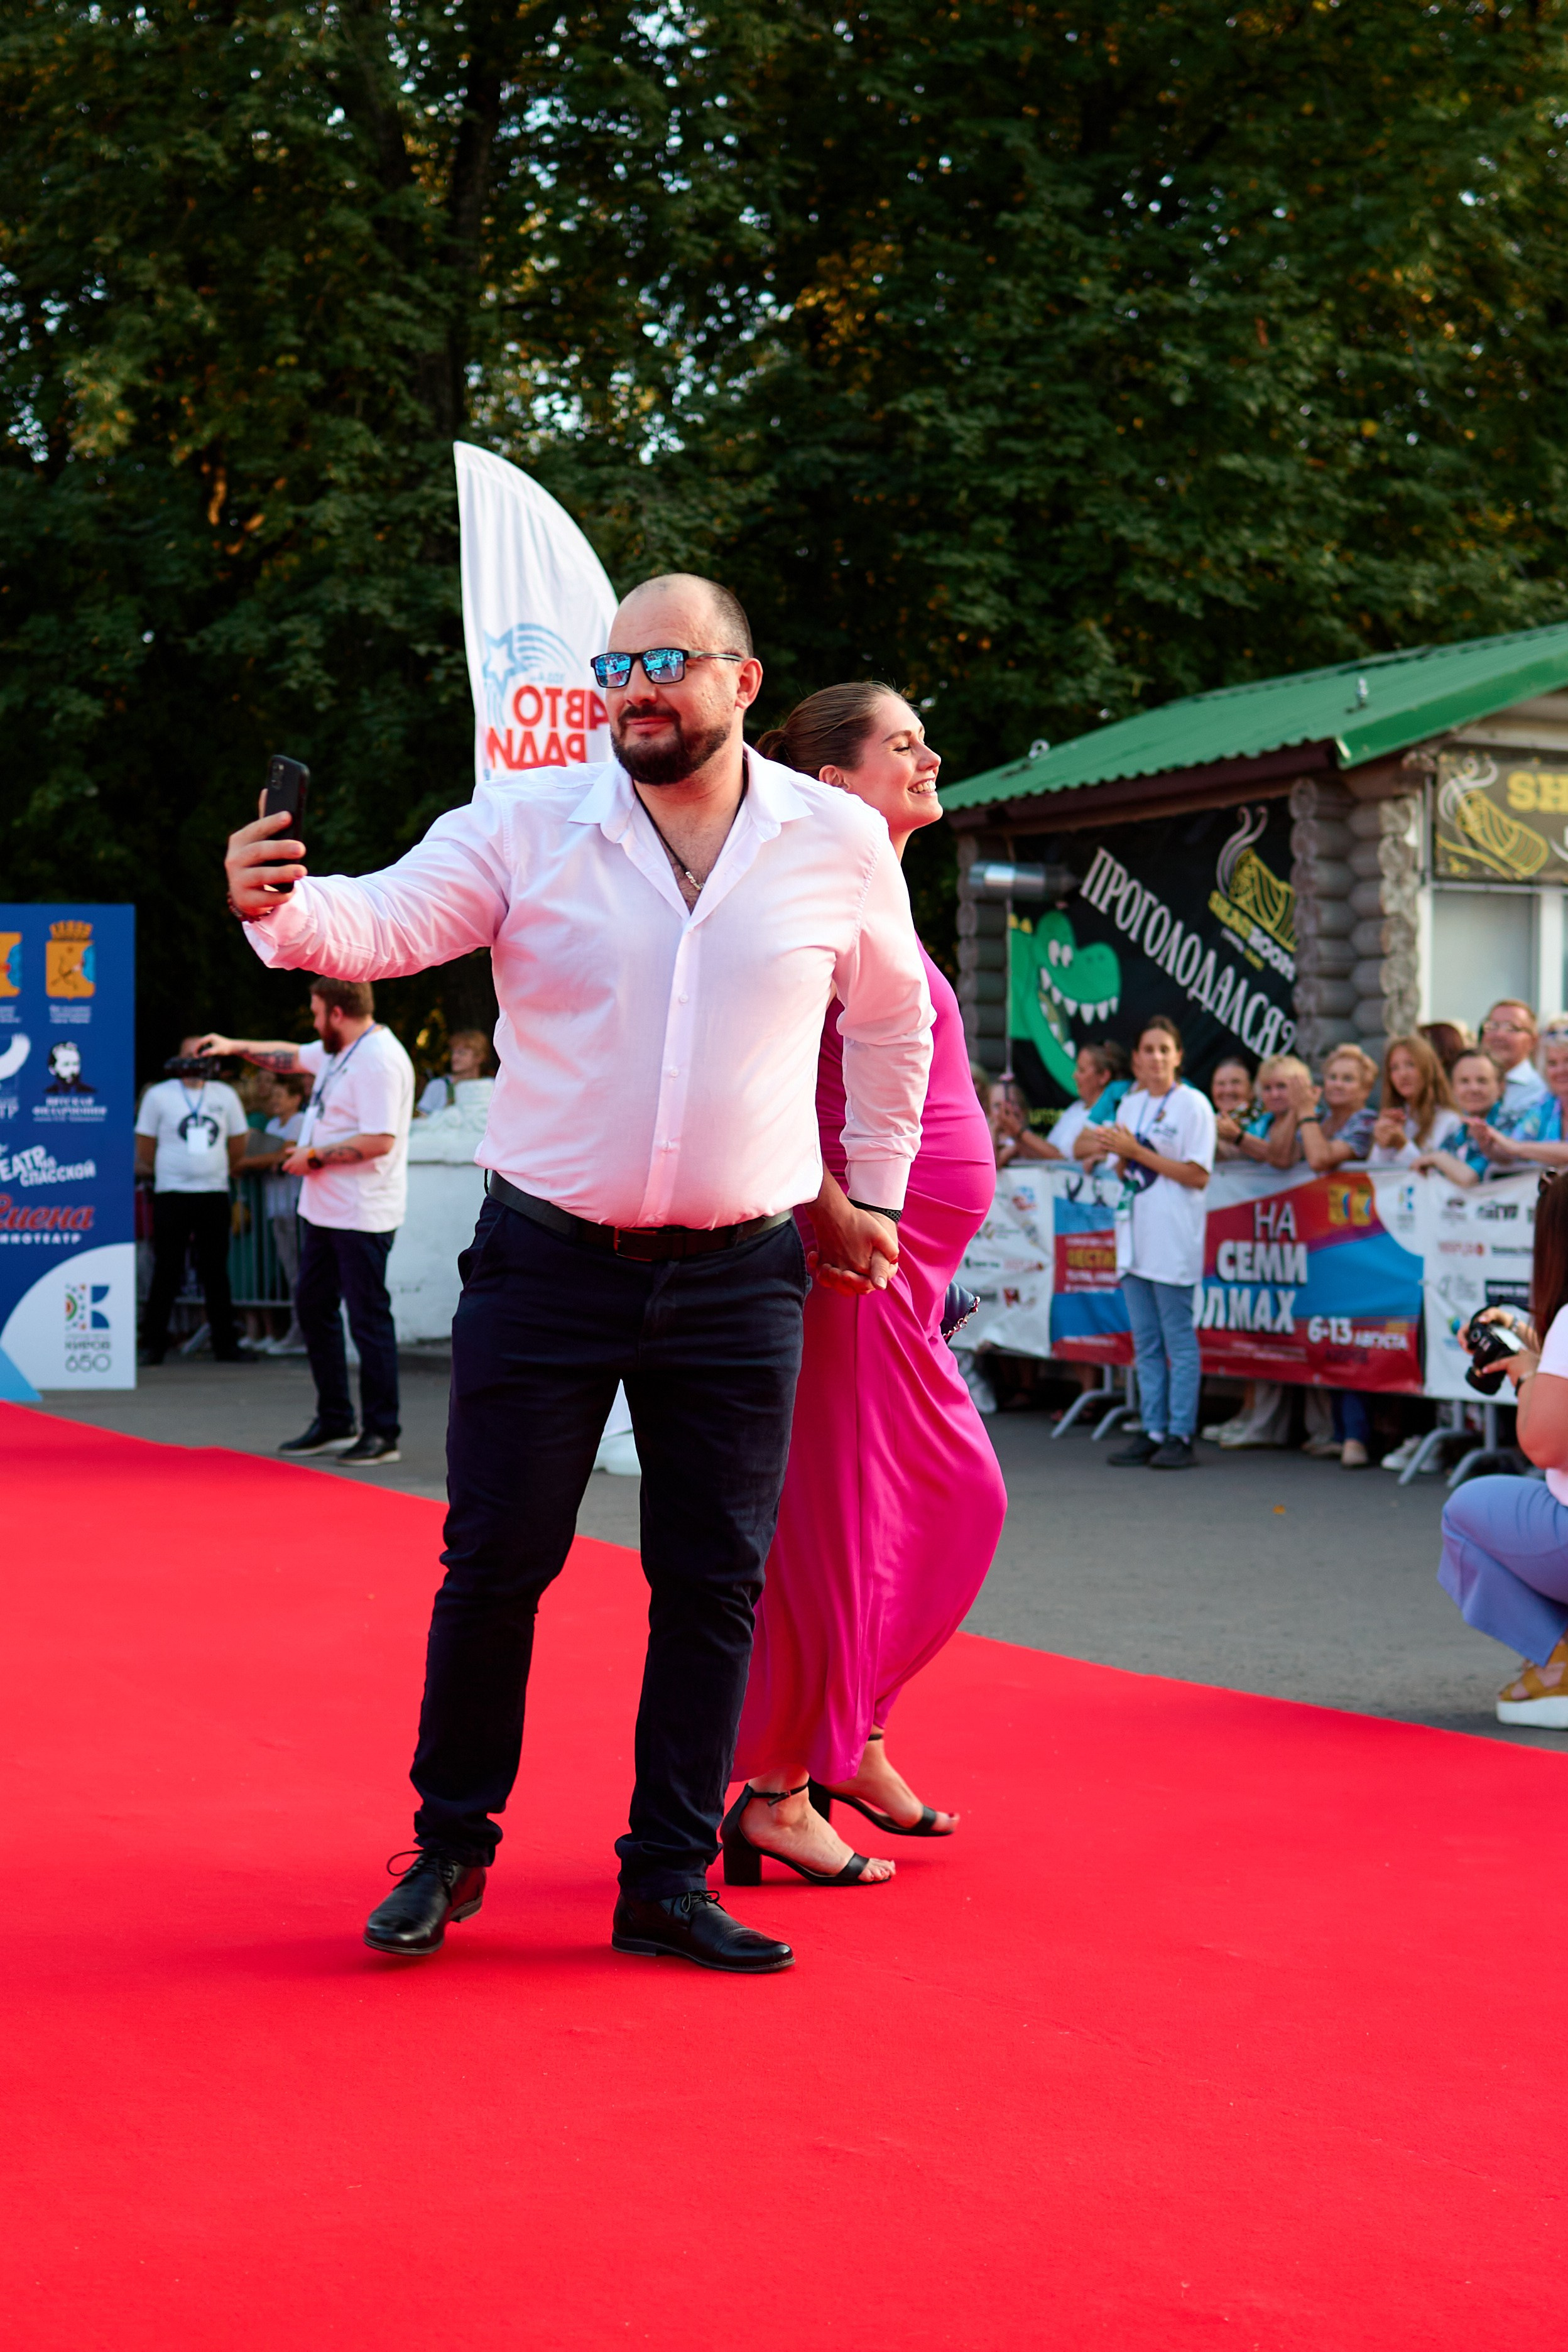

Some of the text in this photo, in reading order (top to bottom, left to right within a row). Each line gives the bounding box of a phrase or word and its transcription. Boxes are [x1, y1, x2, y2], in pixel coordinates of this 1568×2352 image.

[1507, 771, 1568, 812] SH
[1079, 846, 1296, 1060] ПРОГОЛОДАЛСЯ?
[19, 1158, 97, 1188] СПАССКОЙ
[1255, 1201, 1297, 1241] НА
[1217, 1239, 1307, 1284] СЕМИ
[1308, 1315, 1352, 1345] 6-13
[65, 1353, 111, 1373] 650
